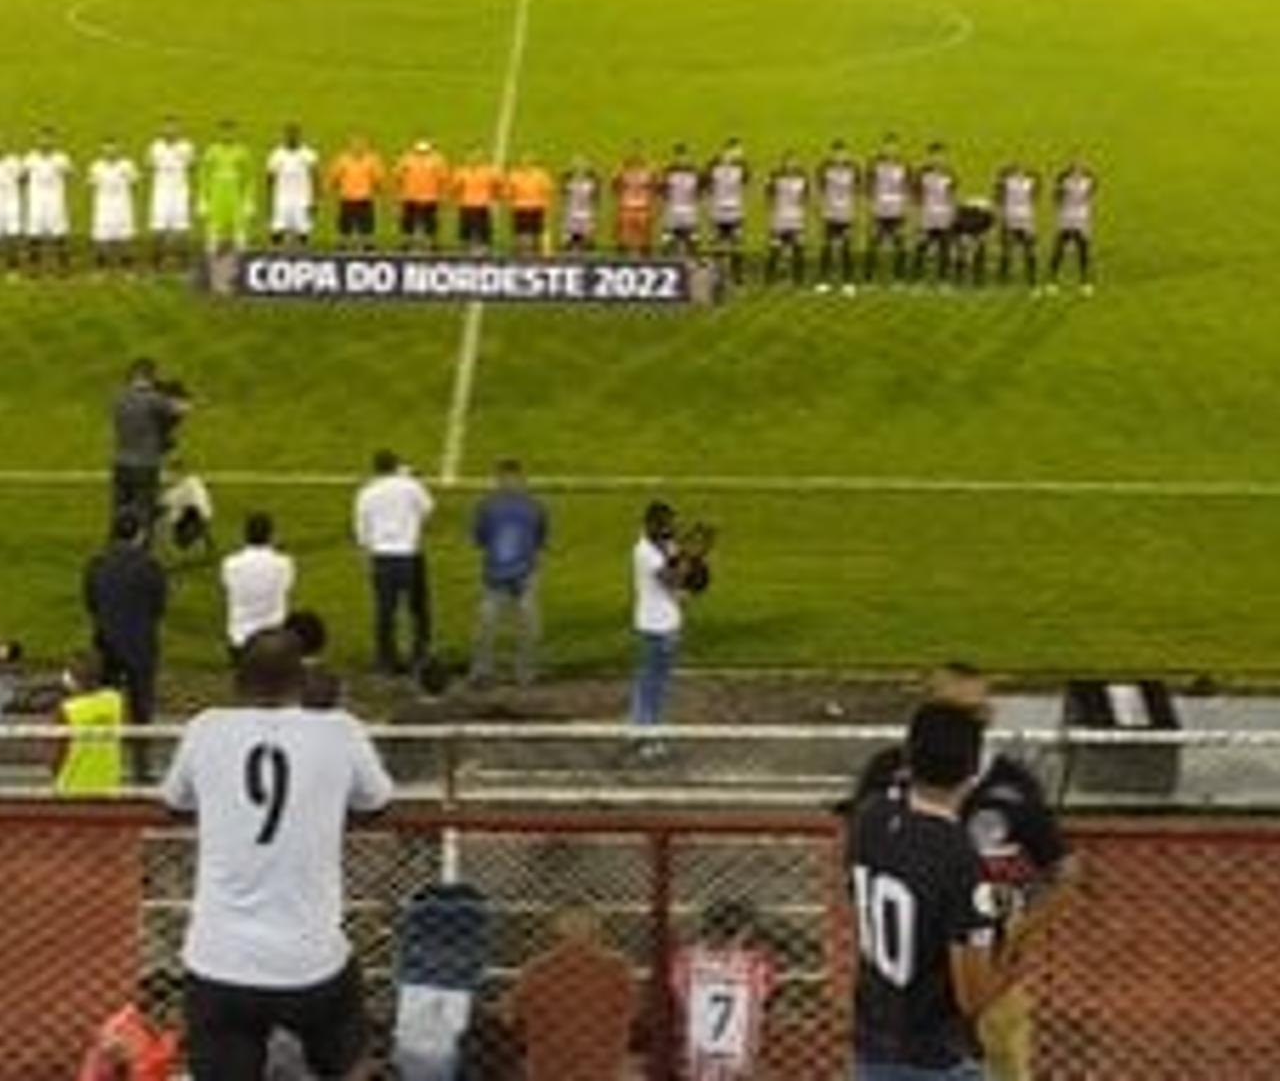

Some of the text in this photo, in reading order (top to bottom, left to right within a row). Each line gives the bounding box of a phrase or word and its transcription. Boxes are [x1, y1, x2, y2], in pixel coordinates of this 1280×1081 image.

[246, 261, 680, 297] COPA DO NORDESTE 2022
[244, 741, 291, 846] 9
[852, 863, 916, 990] 10
[708, 990, 735, 1042] 7
